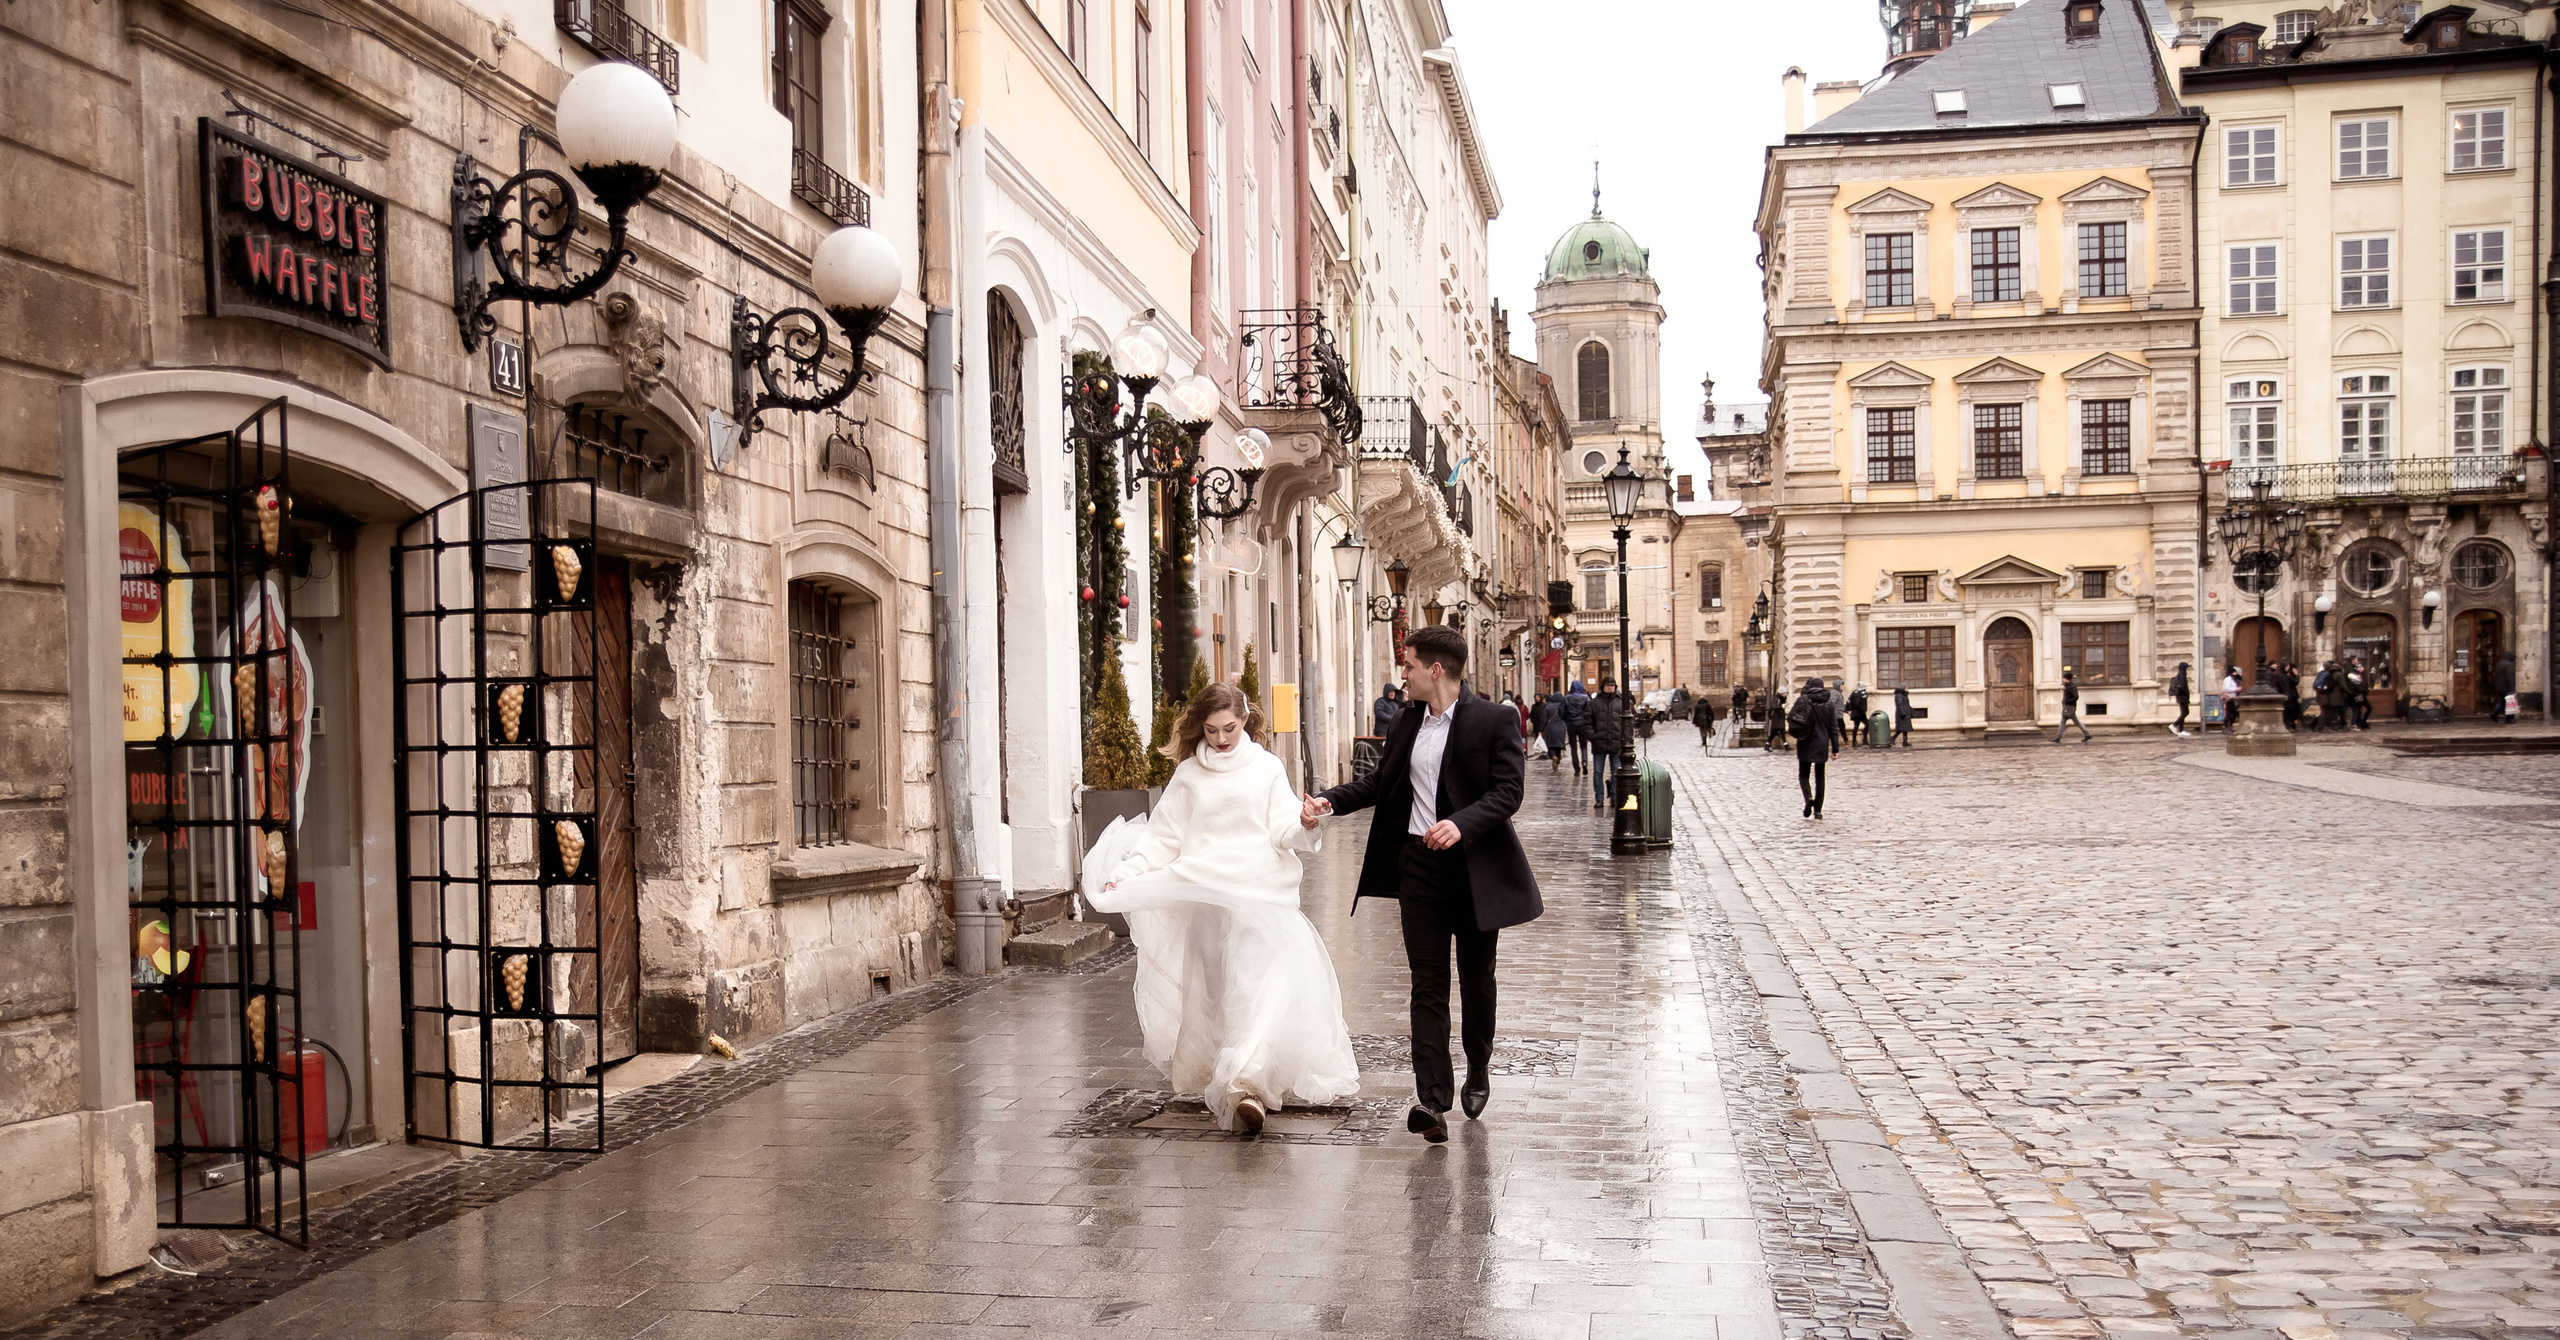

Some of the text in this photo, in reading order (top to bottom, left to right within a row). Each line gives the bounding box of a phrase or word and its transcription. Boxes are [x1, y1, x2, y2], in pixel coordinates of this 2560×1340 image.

[244, 156, 374, 254] BUBBLE
[246, 234, 376, 323] WAFFLE
[498, 343, 521, 390] 41
[121, 580, 158, 600] AFFLE
